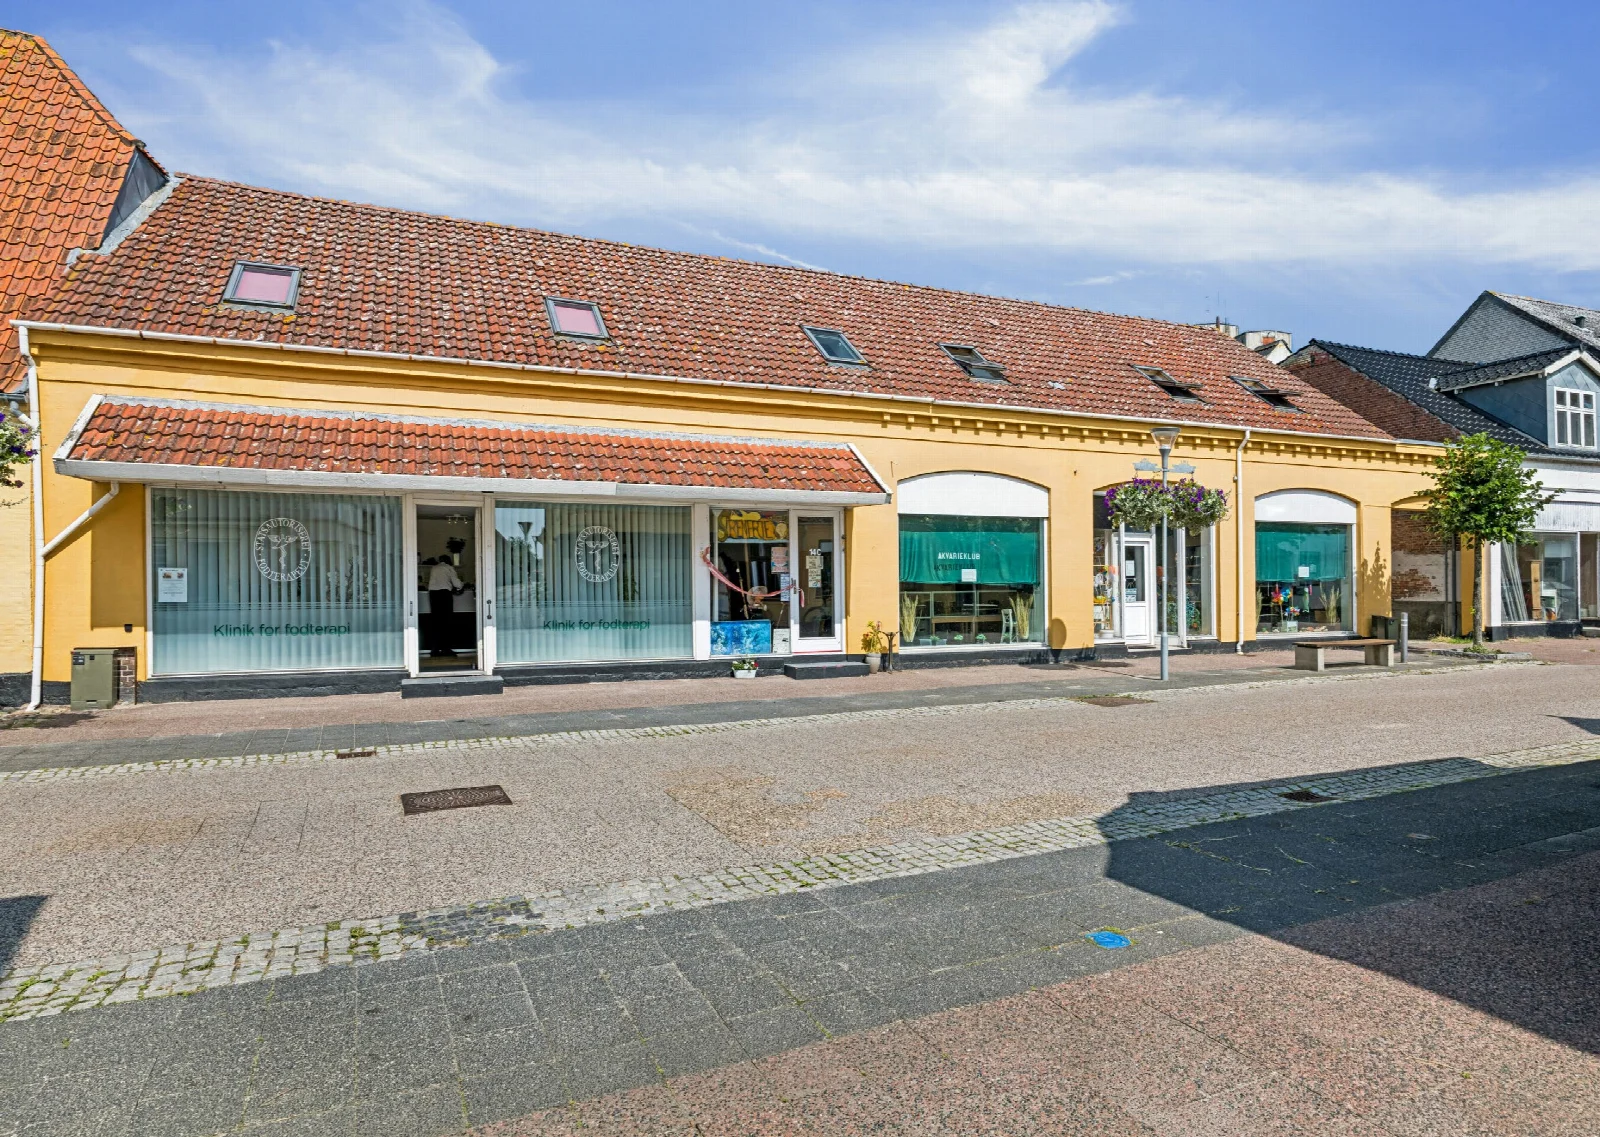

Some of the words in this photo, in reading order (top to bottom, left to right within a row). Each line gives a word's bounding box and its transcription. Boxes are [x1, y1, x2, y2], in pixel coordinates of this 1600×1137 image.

[255, 519, 311, 551] STATSAUTORISERET
[937, 552, 981, 560] AKVARIEKLUB
[257, 558, 309, 580] FODTERAPEUT
[213, 624, 254, 637] Klinik
[259, 623, 280, 636] for
[285, 622, 351, 637] fodterapi
[543, 619, 575, 632] Klinik
[579, 619, 595, 631] for
[599, 618, 650, 632] fodterapi
